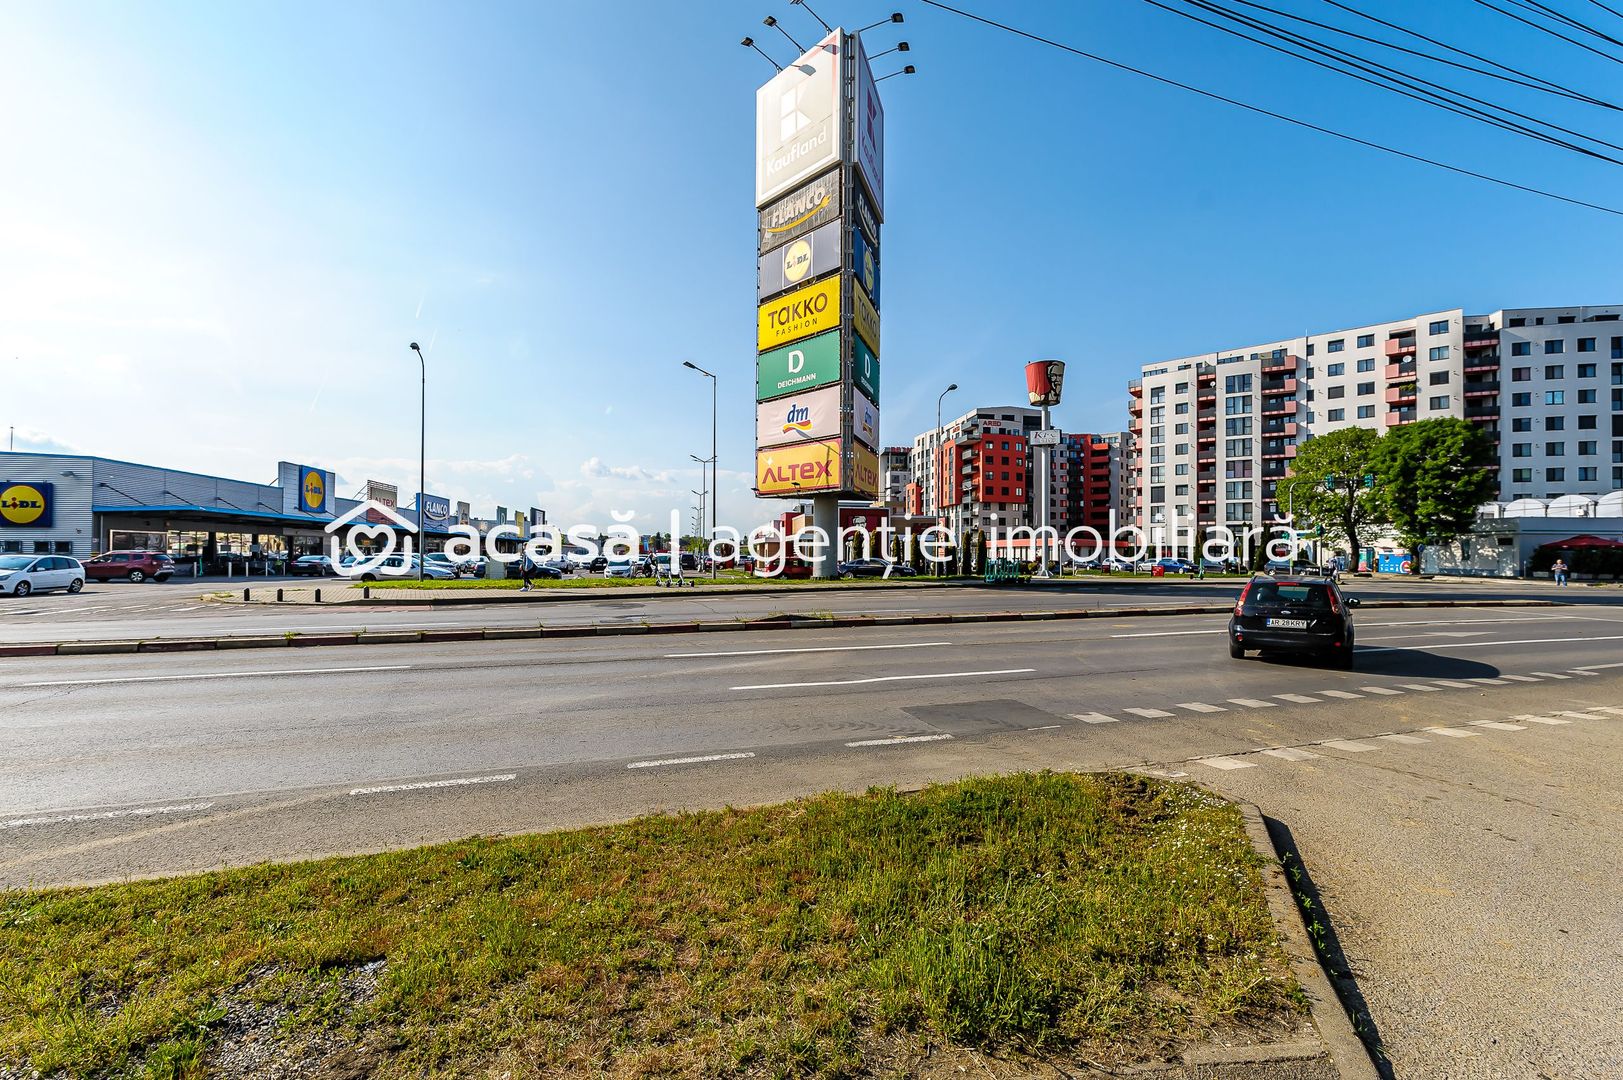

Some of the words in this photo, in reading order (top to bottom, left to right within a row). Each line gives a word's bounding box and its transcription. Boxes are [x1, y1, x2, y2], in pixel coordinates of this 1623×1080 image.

[766, 126, 826, 176] Kaufland
[772, 187, 826, 227] FLANCO
[776, 317, 818, 337] FASHION
[788, 350, 805, 374] D
[864, 353, 871, 379] D
[777, 373, 817, 389] DEICHMANN
[787, 404, 809, 424] dm
[425, 501, 448, 515] FLANCO
